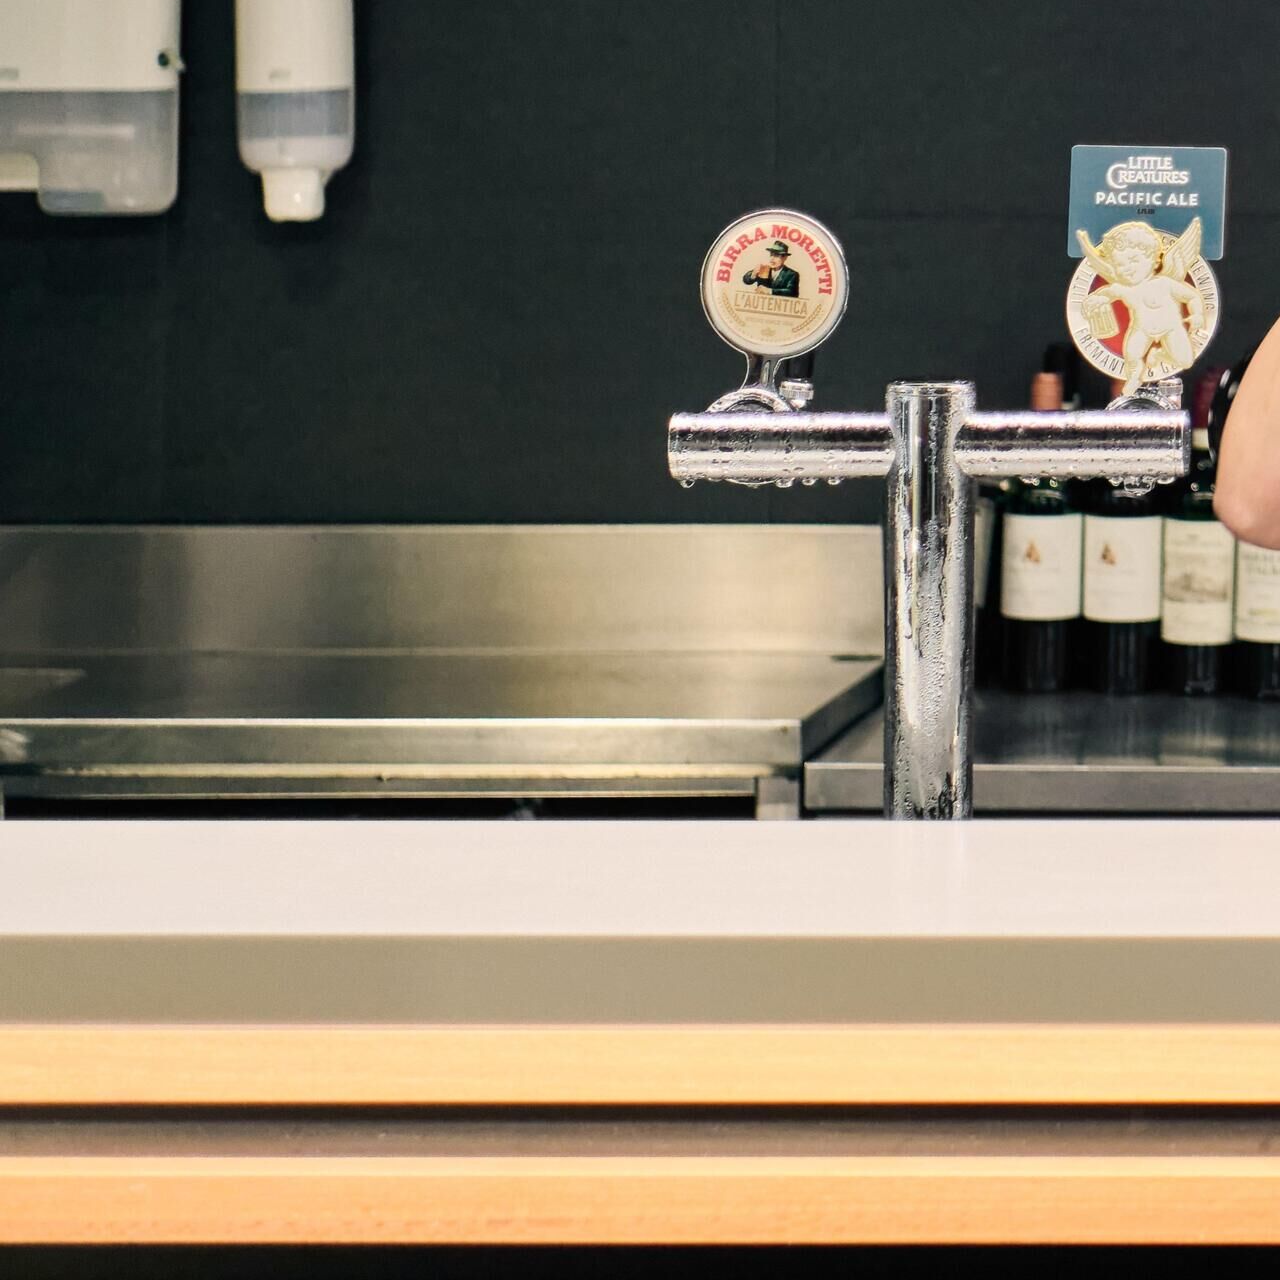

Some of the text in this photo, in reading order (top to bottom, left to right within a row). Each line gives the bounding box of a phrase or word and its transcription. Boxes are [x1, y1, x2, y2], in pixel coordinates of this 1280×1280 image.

[1127, 156, 1174, 170] LITTLE
[1106, 163, 1190, 189] CREATURES
[1095, 191, 1200, 207] PACIFIC ALE
[716, 224, 833, 296] BIRRA MORETTI
[733, 292, 810, 316] L'AUTENTICA
[1076, 327, 1126, 375] FREMANT
